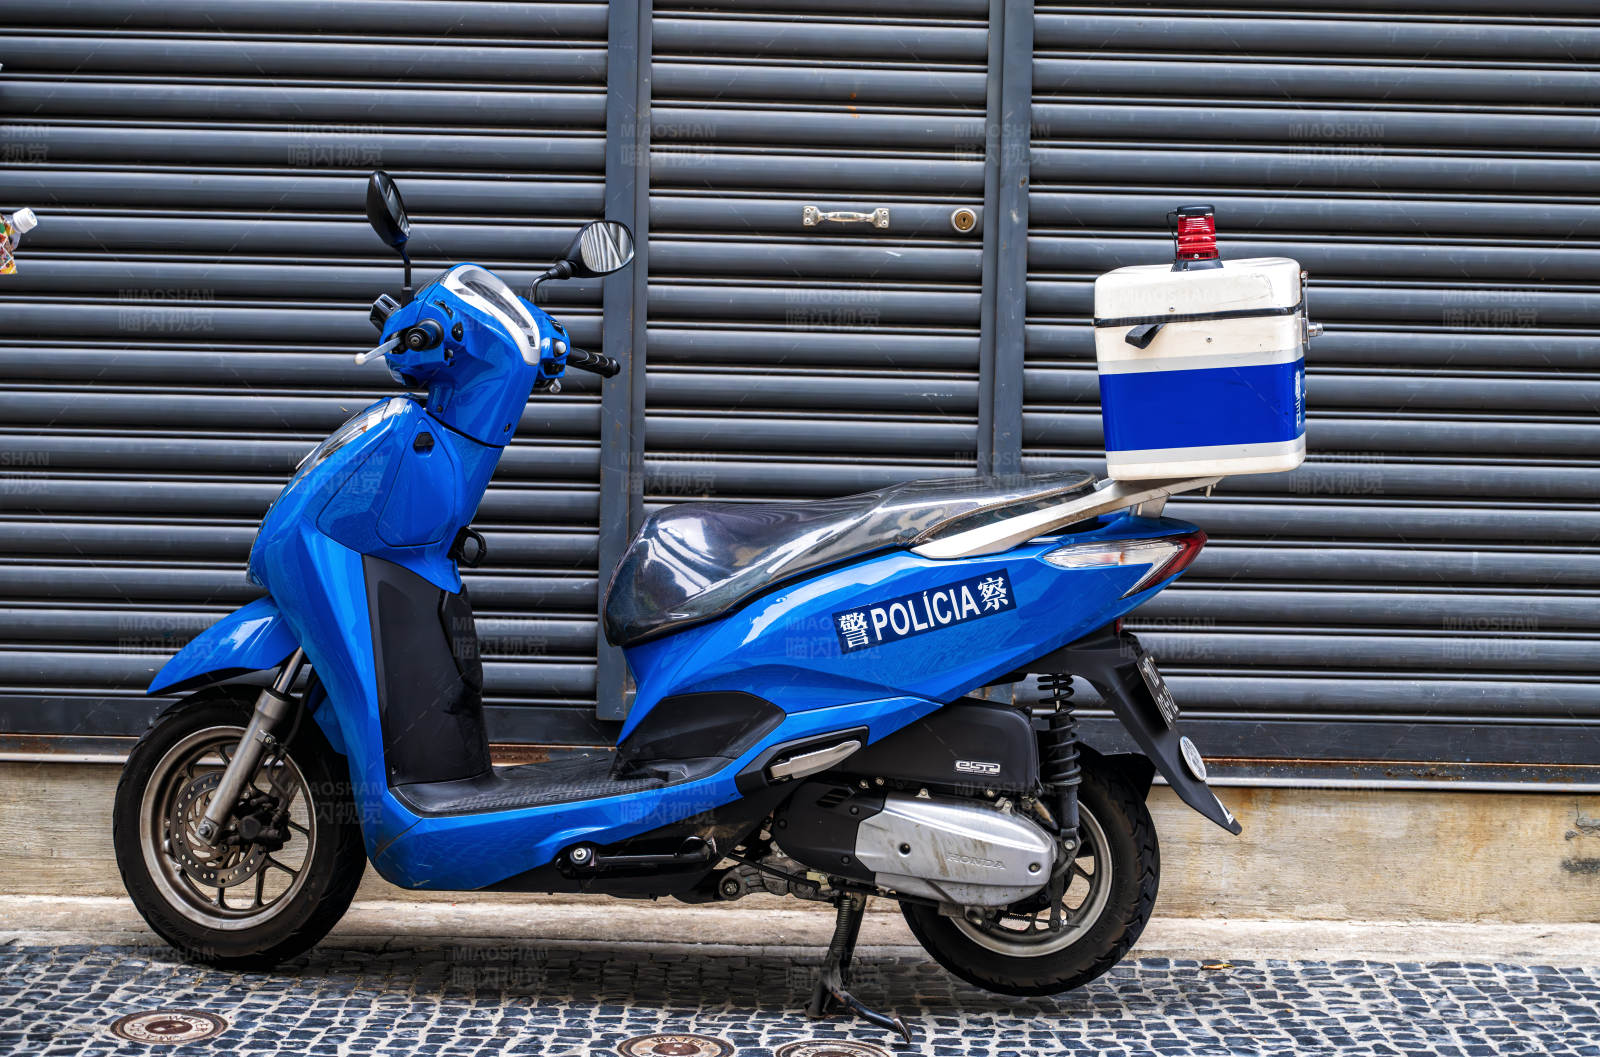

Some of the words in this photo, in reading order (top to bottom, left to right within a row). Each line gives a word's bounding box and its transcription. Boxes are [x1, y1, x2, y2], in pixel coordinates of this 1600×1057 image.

[838, 612, 869, 648] 警
[870, 586, 981, 641] POLÍCIA
[977, 576, 1009, 612] 察
[946, 851, 1007, 870] HONDA
